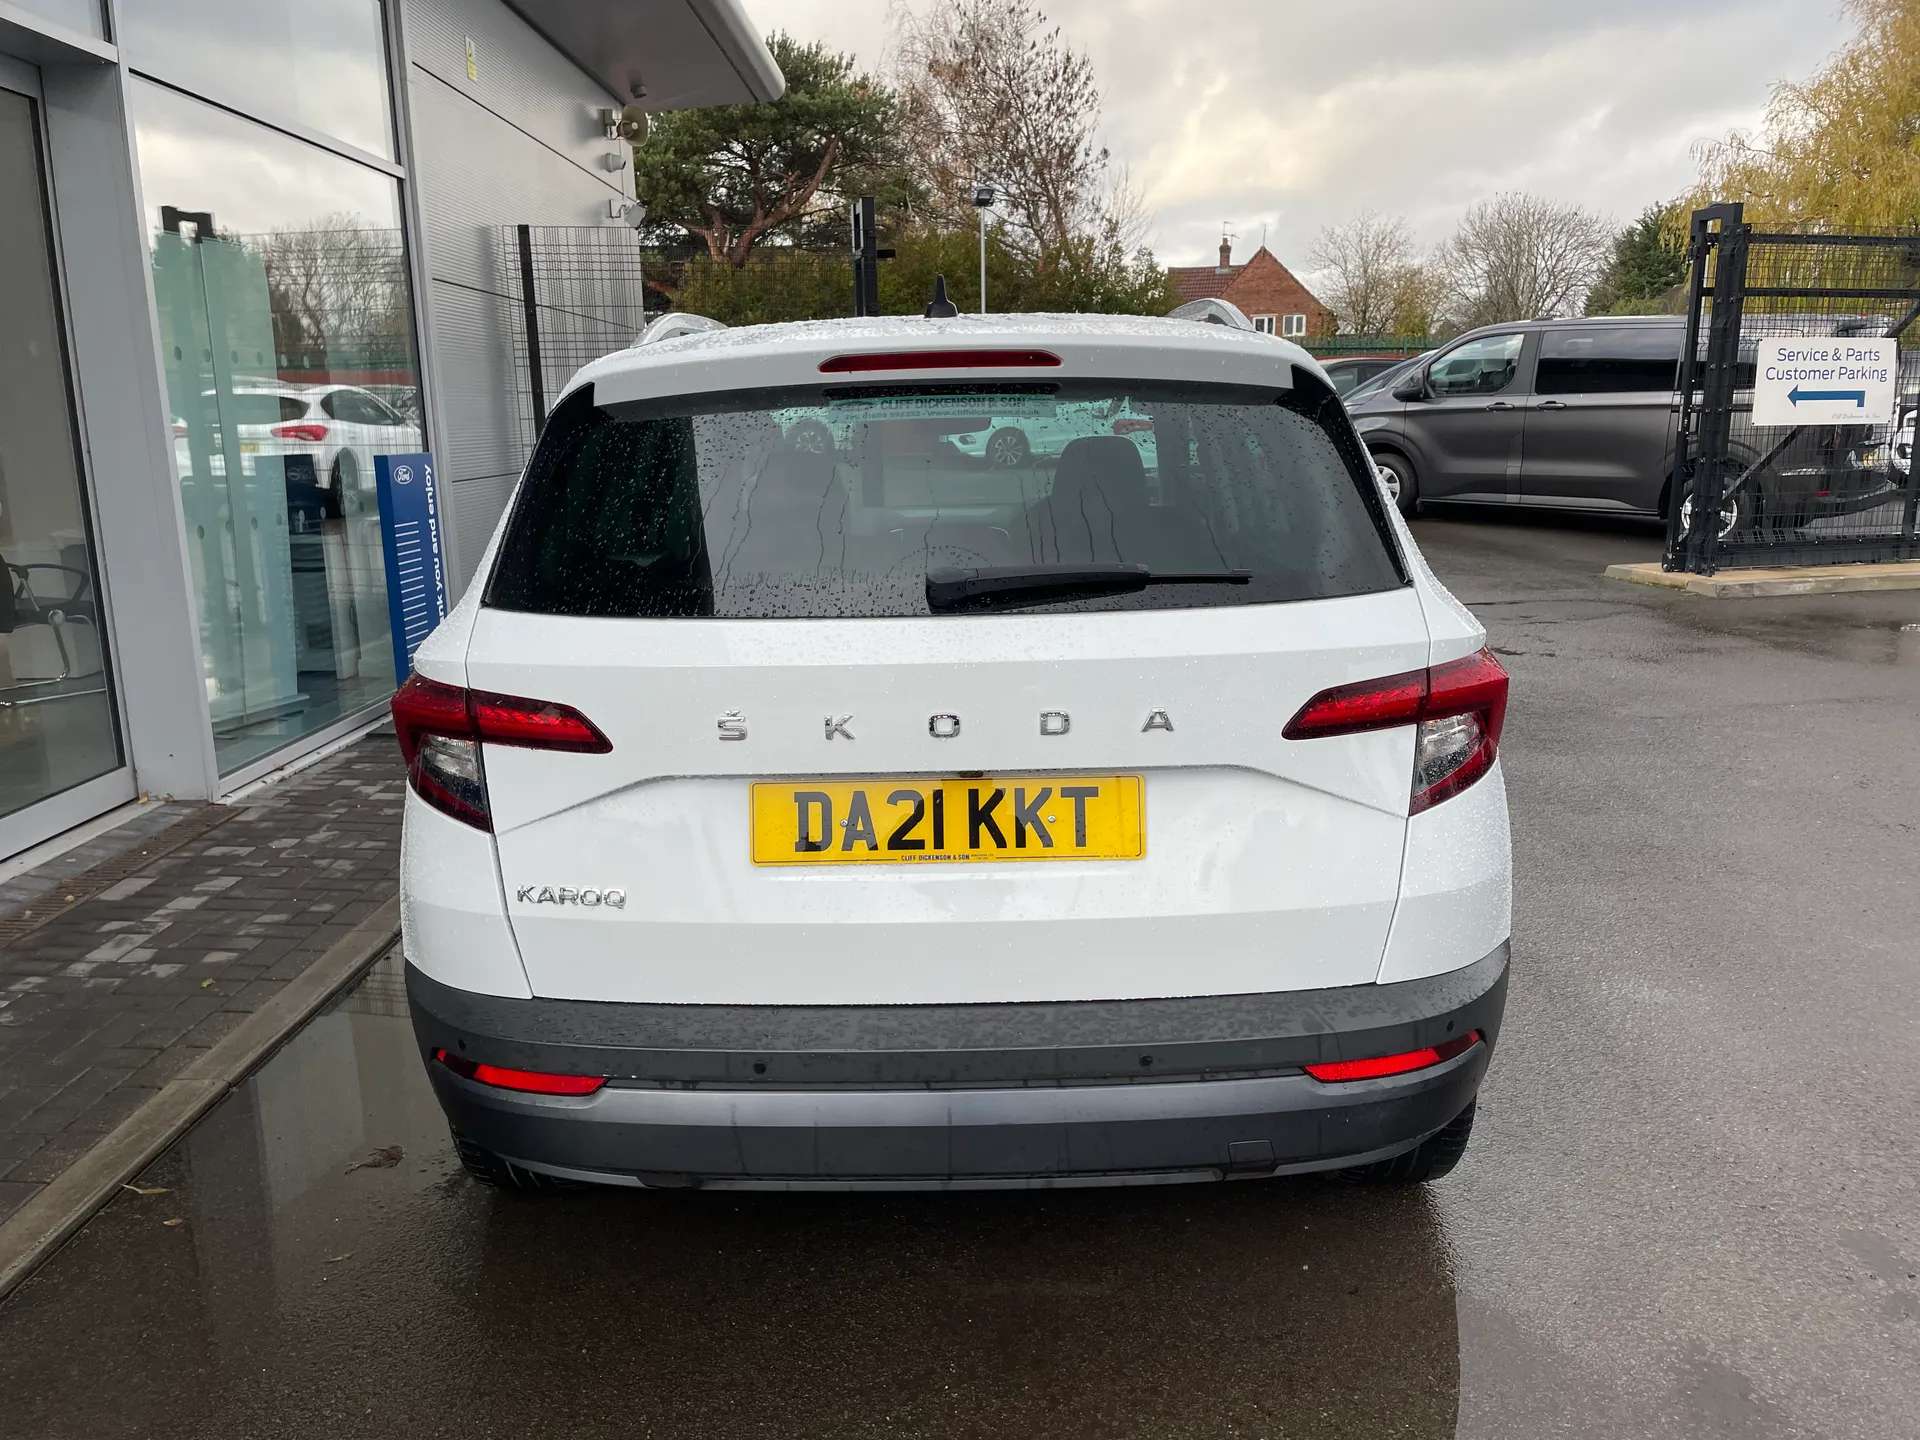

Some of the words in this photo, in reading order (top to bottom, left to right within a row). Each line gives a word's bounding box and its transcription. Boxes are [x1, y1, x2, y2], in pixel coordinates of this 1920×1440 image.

[1777, 348, 1829, 361] Service
[1832, 348, 1841, 361] &
[1846, 348, 1880, 361] Parts
[1766, 367, 1835, 381] Customer
[1838, 366, 1887, 382] Parking
[881, 399, 914, 410] CLIFF
[915, 397, 987, 410] DICKENSON
[424, 464, 435, 515] enjoy
[428, 518, 438, 554] and
[434, 558, 443, 591] you
[794, 789, 944, 852] DA21
[968, 787, 1098, 849] KKT
[517, 886, 626, 909] KAROQ
